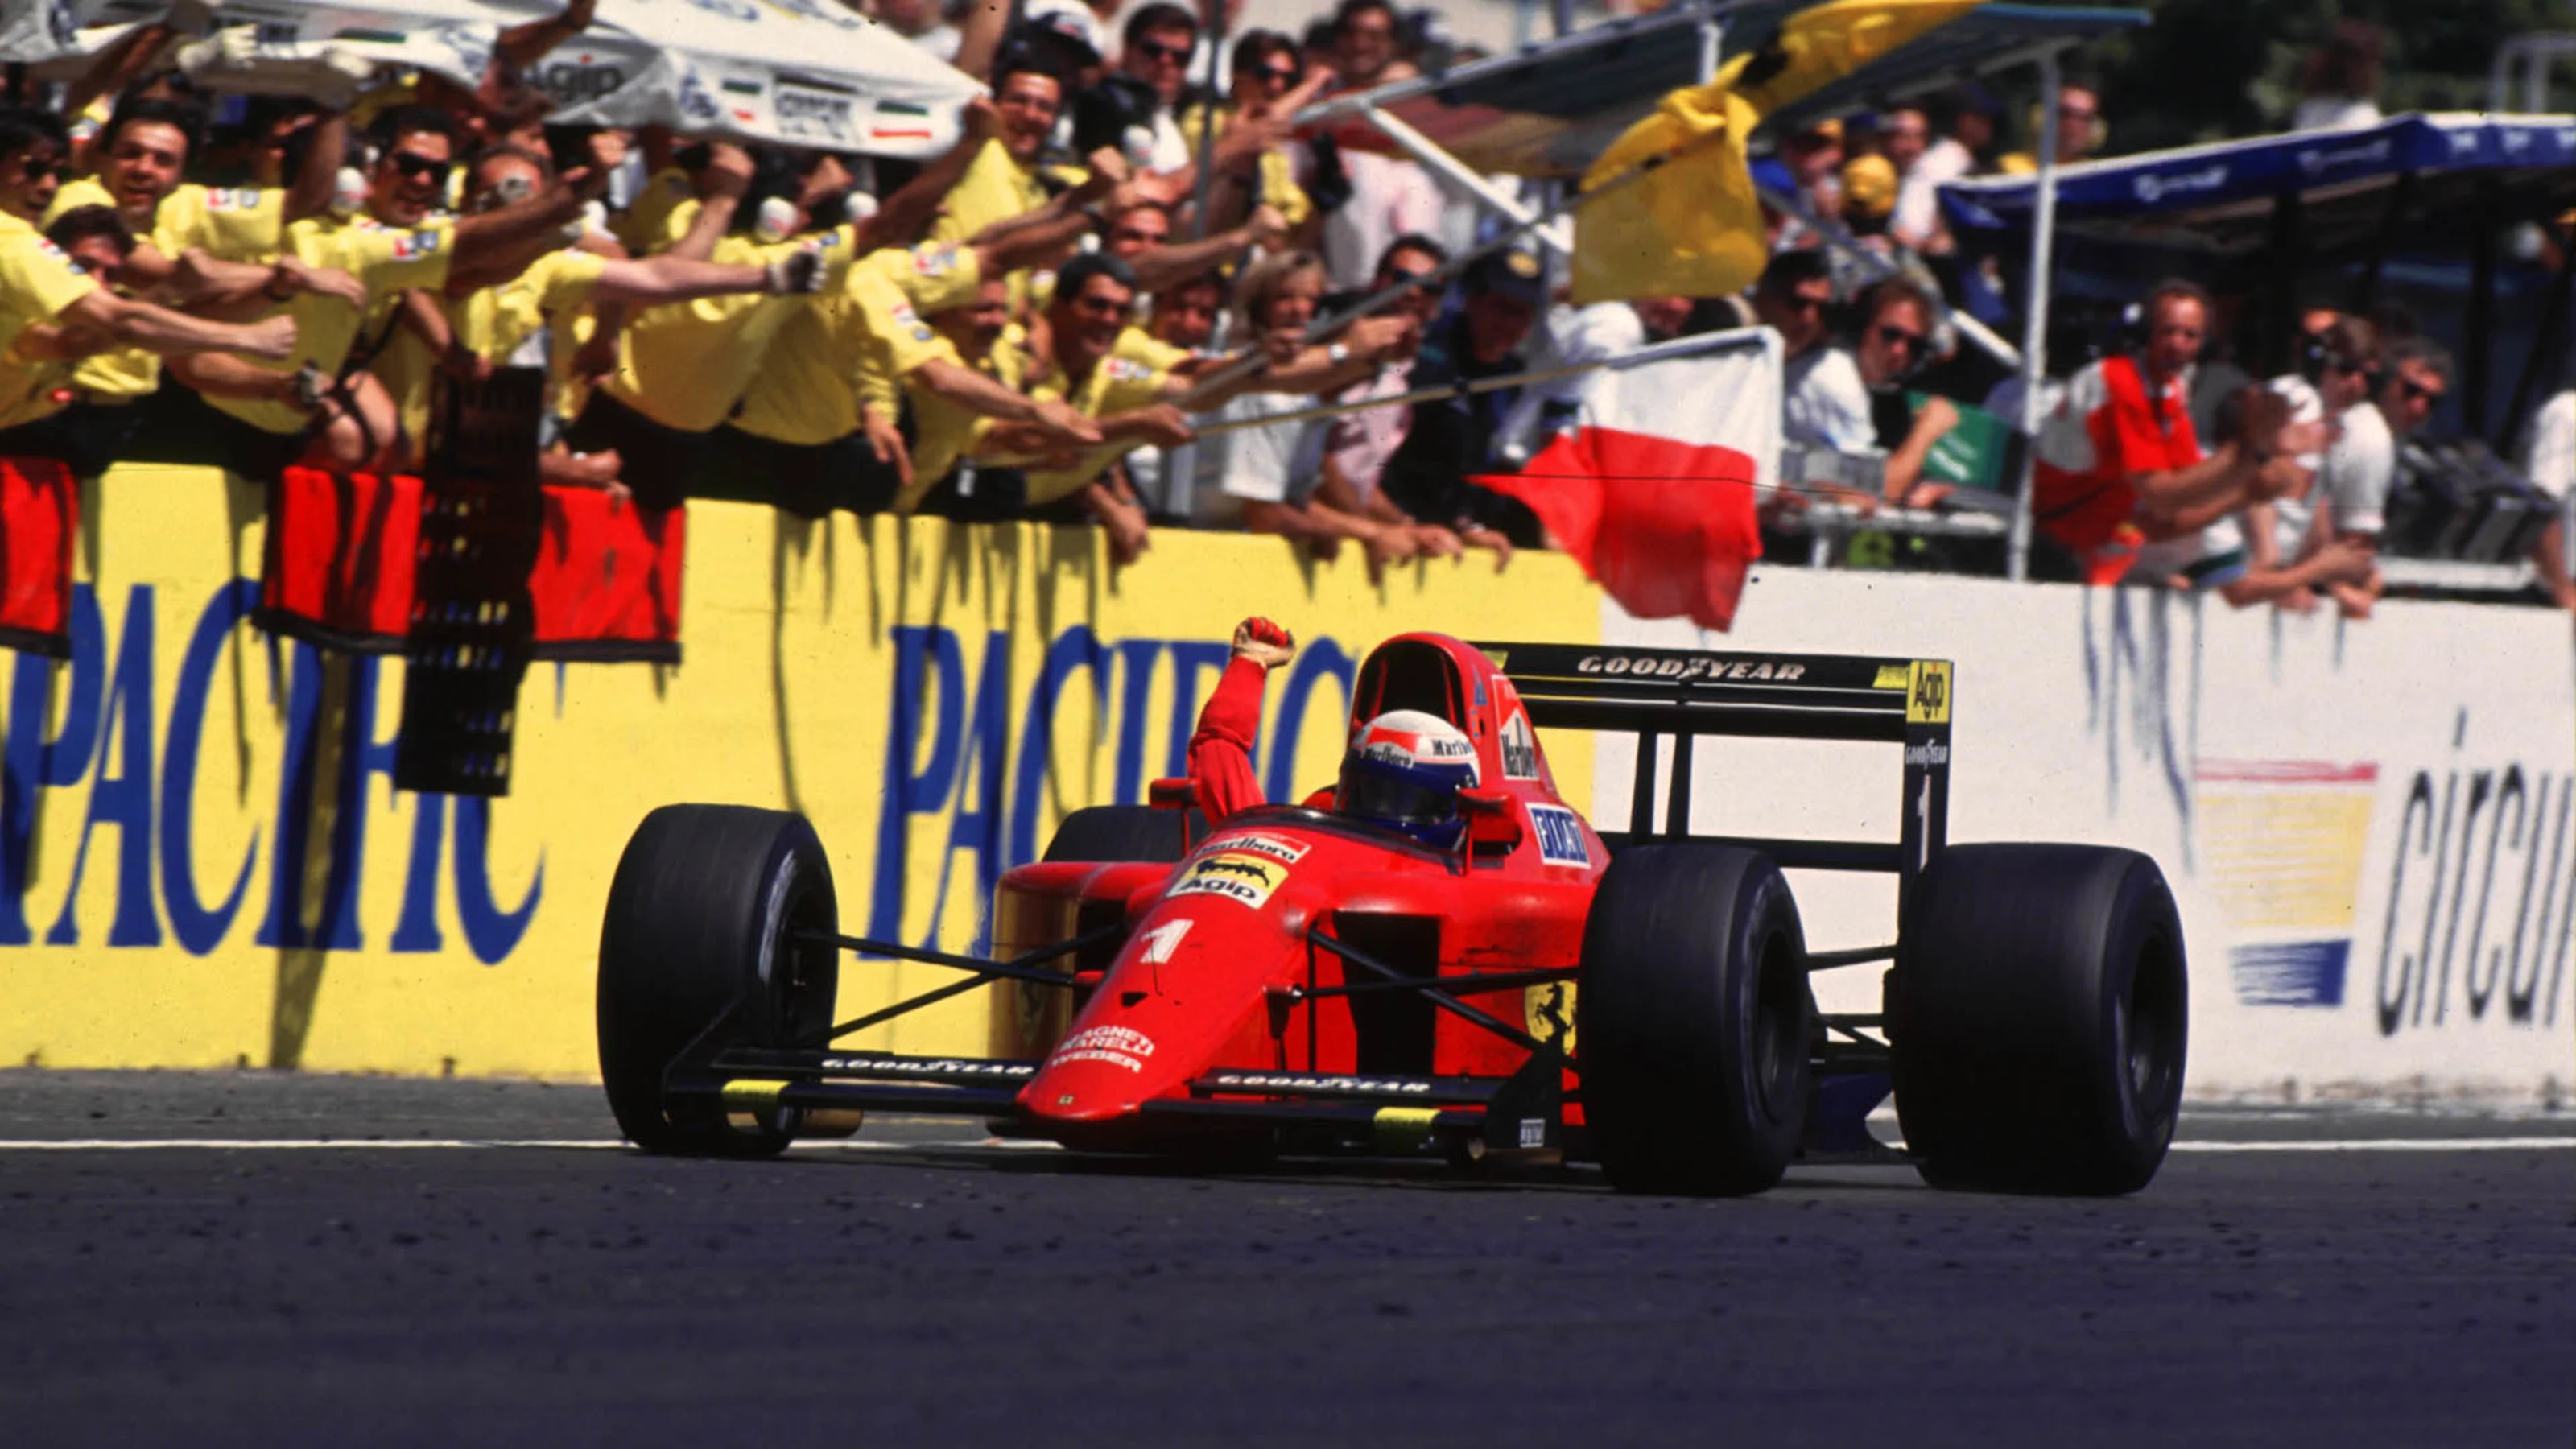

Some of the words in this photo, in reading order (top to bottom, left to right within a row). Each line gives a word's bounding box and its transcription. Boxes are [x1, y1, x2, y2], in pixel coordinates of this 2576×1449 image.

[1577, 655, 1806, 681] GOODYEAR
[1913, 662, 1945, 720] Agip
[857, 625, 1362, 960] PACIFC
[1533, 811, 1586, 858] FIAT
[1178, 877, 1256, 900] Agip
[1139, 919, 1195, 964] 1
[821, 1058, 1034, 1075] GOODYEAR
[1051, 1049, 1142, 1073] WEBER
[1217, 1075, 1430, 1092] GOODYEAR
